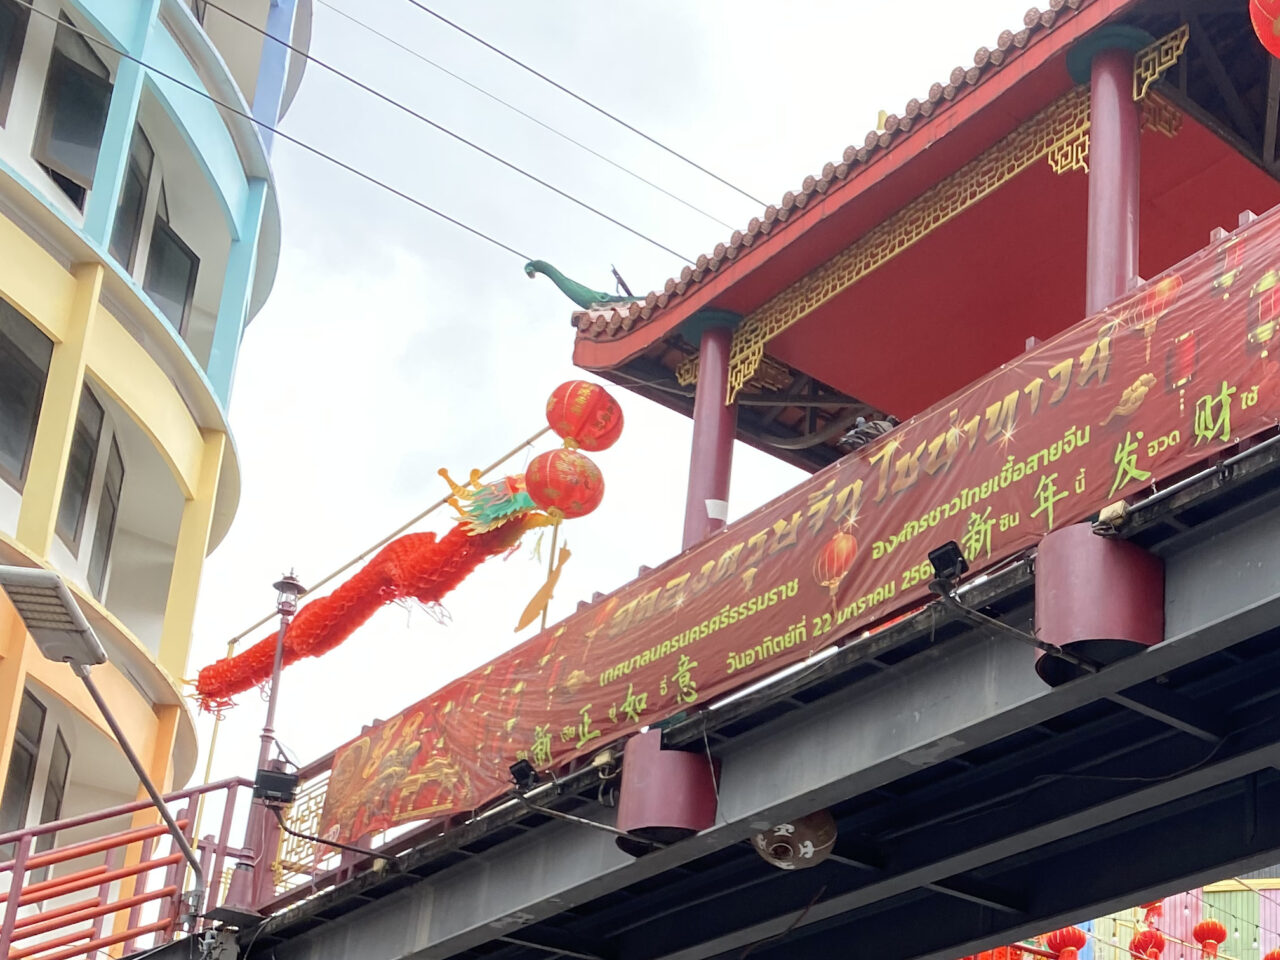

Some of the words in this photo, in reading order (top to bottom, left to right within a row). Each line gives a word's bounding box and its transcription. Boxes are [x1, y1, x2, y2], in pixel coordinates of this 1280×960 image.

[1030, 472, 1069, 530] 年
[1107, 431, 1152, 500] 发
[1147, 430, 1181, 457] ฮวด
[1194, 380, 1237, 448] 财
[600, 578, 799, 687] เทศบาลนครนครศรีธรรมราช
[872, 425, 1091, 560] องค์กรชาวไทยเชื้อสายจีน
[726, 614, 807, 674] วันอาทิตย์ที่
[812, 613, 832, 638] 22
[837, 580, 896, 625] มกราคม
[901, 561, 937, 590] 256
[620, 683, 648, 723] 如
[671, 654, 698, 703] 意
